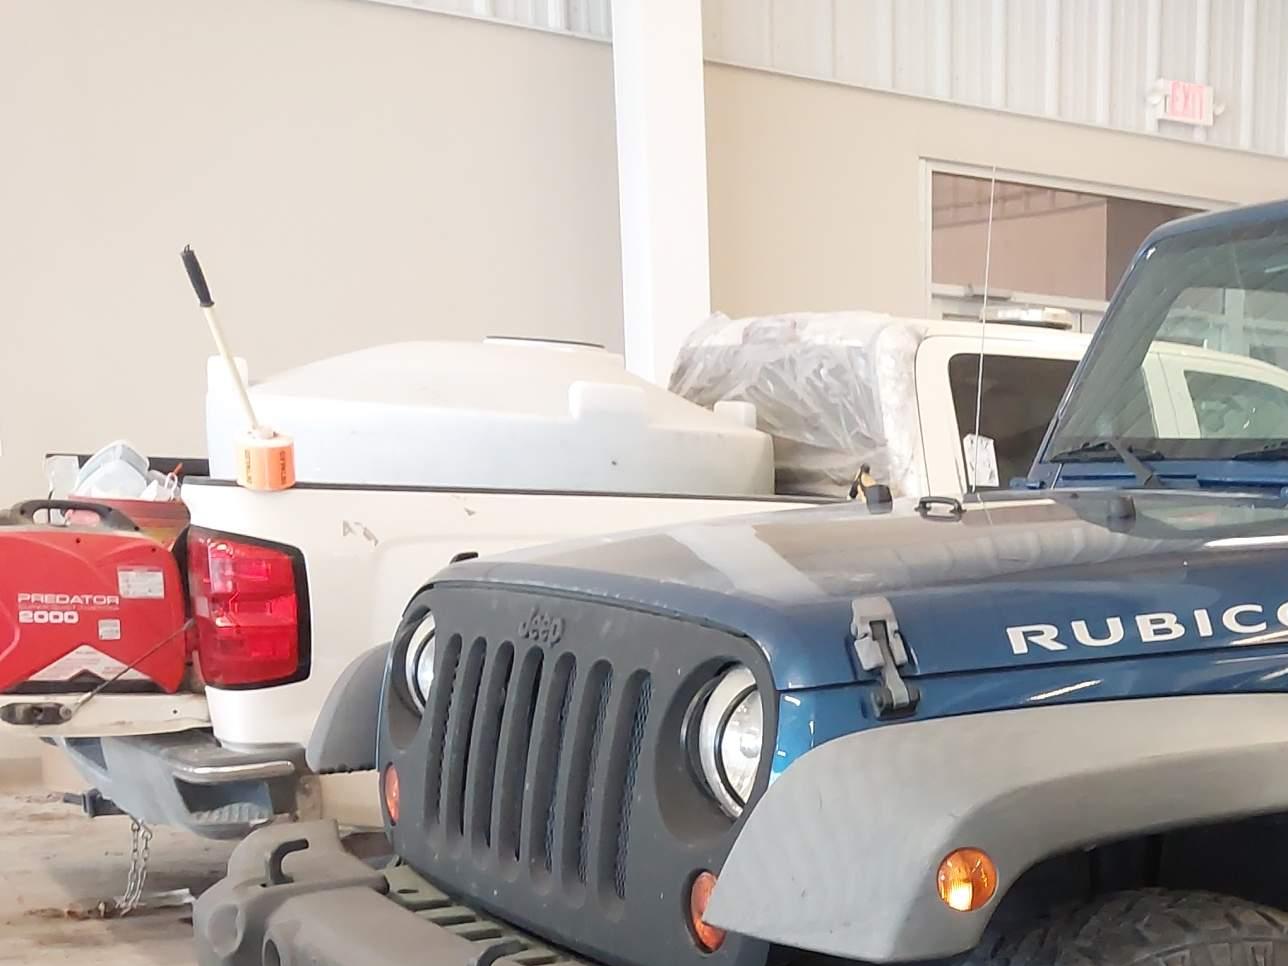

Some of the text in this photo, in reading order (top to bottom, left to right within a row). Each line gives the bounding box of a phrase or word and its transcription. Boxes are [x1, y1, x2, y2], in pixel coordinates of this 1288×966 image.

[1170, 81, 1205, 120] EXIT
[18, 593, 120, 605] PREDATOR
[18, 610, 79, 624] 2000
[519, 607, 564, 648] Jeep
